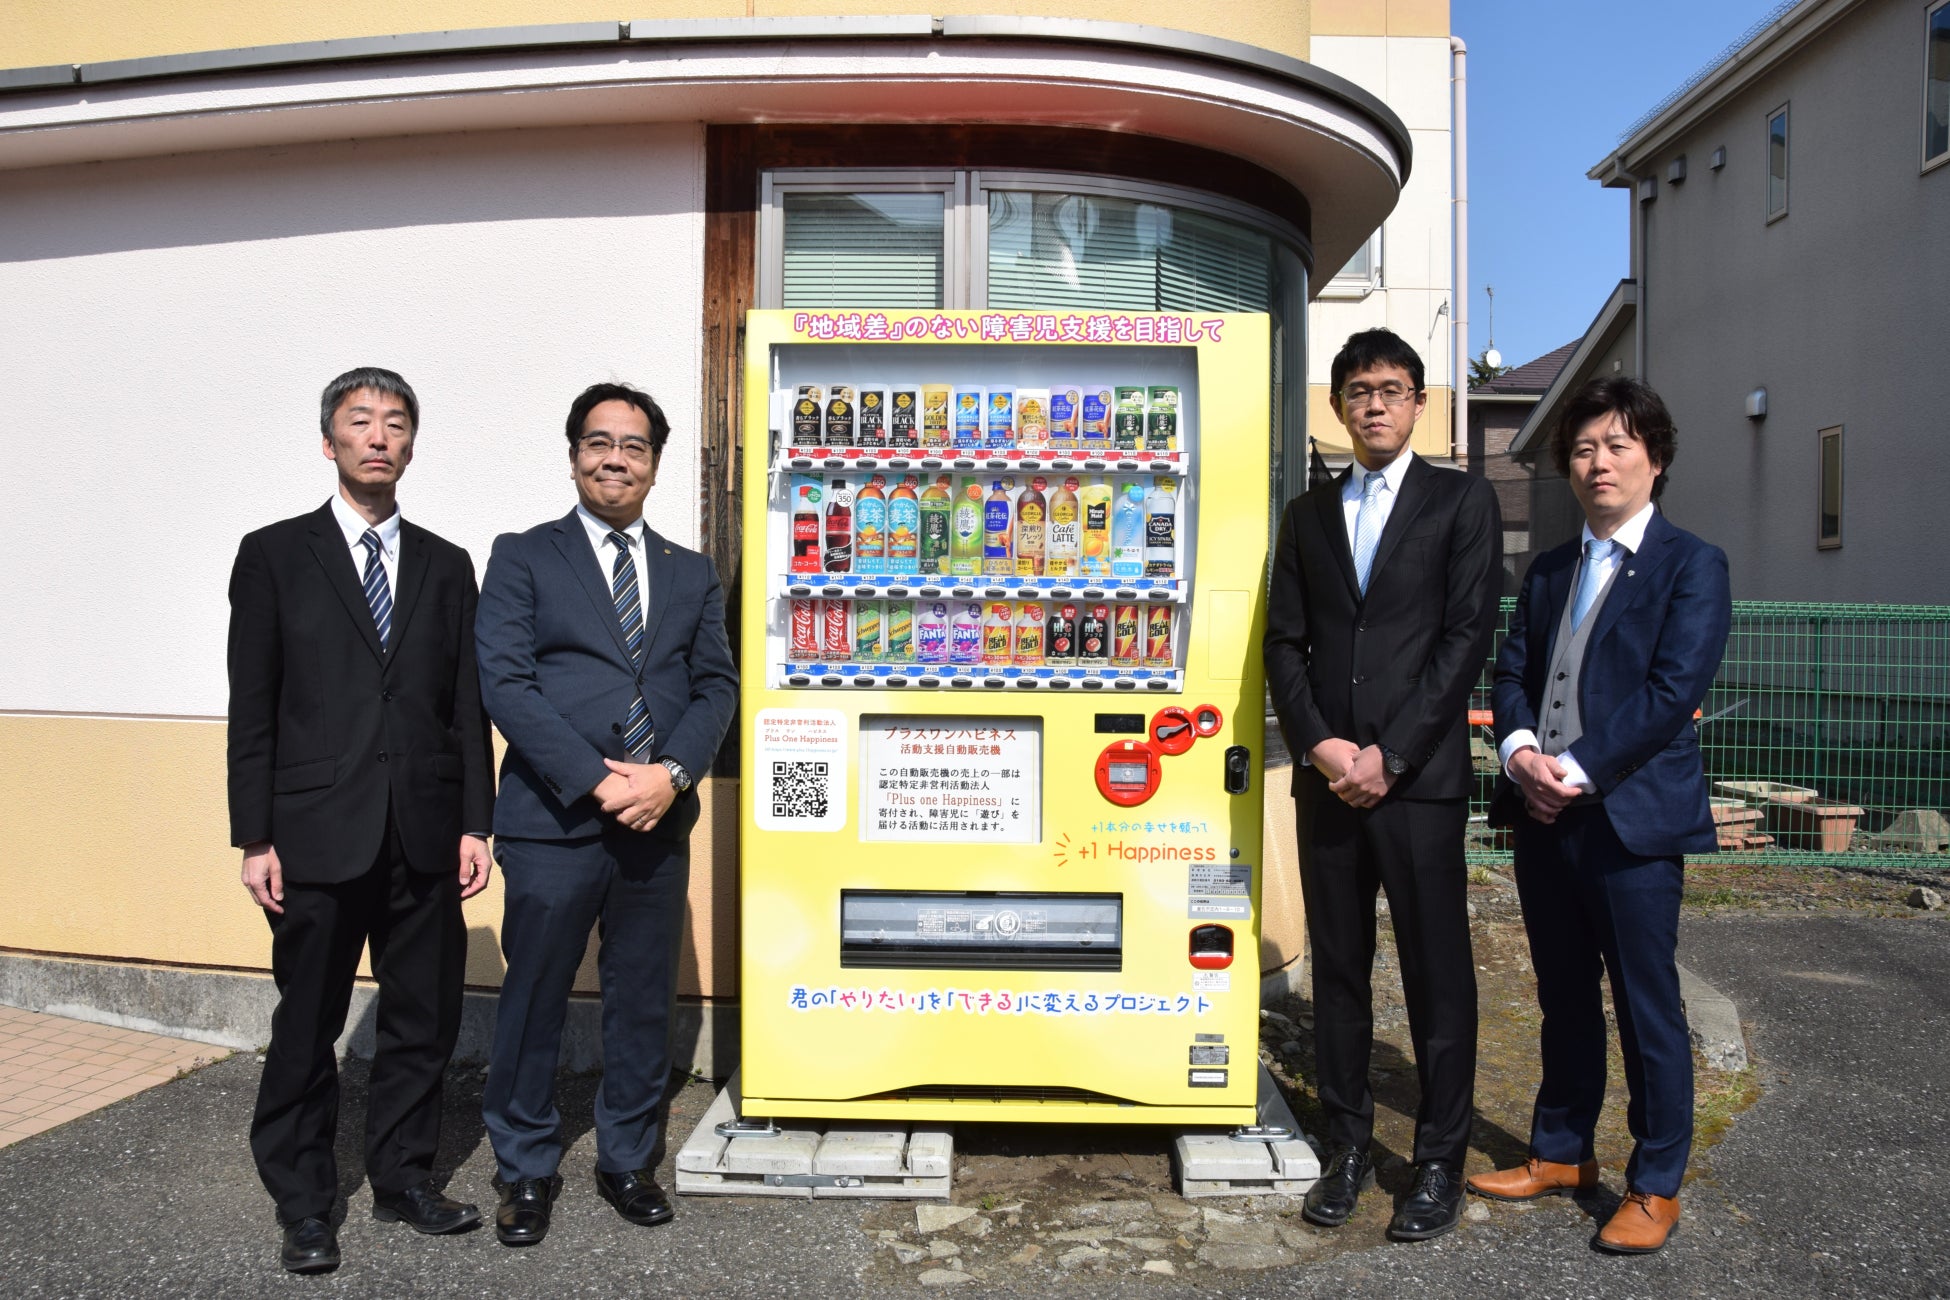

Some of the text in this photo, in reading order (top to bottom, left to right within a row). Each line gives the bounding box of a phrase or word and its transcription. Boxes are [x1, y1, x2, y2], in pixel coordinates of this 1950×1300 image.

[794, 313, 1225, 342] 『地域差』のない障害児支援を目指して
[860, 416, 883, 424] BLACK
[892, 416, 915, 424] BLACK
[857, 507, 884, 523] 麦茶
[889, 508, 917, 523] 麦茶
[986, 512, 1007, 520] 紅茶花伝
[1052, 524, 1075, 533] Café
[1052, 534, 1075, 542] LATTE
[1117, 619, 1136, 630] REAL
[1149, 620, 1169, 630] REAL
[919, 628, 946, 640] FANTA
[953, 629, 980, 640] FANTA
[1116, 627, 1136, 637] GOLD
[1149, 628, 1169, 638] GOLD
[763, 718, 837, 726] 認定特定非営利活動法人
[884, 726, 1017, 741] プラスワンハピネス
[764, 734, 839, 745] Plus One Happiness
[900, 743, 1002, 756] 活動支援自動販売機
[878, 767, 1021, 778] この自動販売機の売上の一部は
[878, 779, 990, 791] 認定特定非営利活動法人
[920, 795, 938, 805] one
[1011, 797, 1020, 806] に
[878, 808, 1020, 820] 寄付され、障害児に「遊び」を
[878, 820, 1006, 832] 届ける活動に活用されます。
[1090, 821, 1209, 834] +1本分の幸せを願って
[1078, 840, 1216, 863] +1 Happiness
[790, 987, 1211, 1013] 君の「やりたい」を「できる」に変えるプロジェクト
